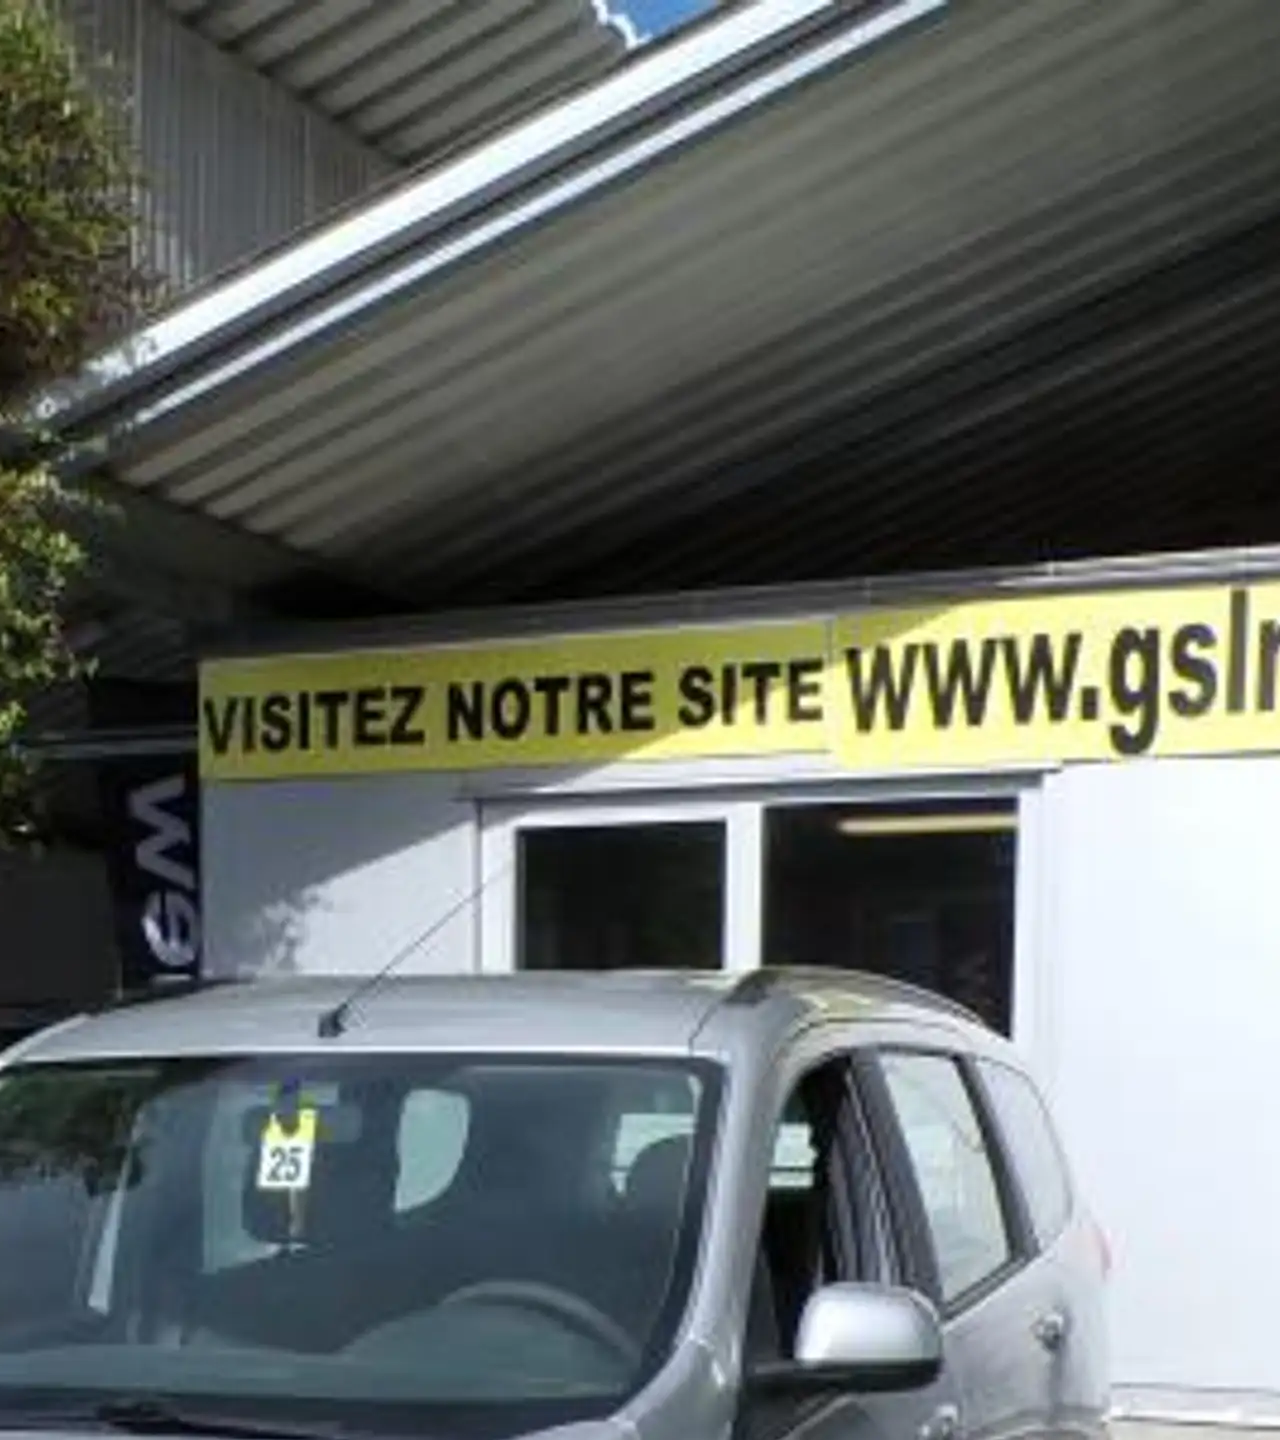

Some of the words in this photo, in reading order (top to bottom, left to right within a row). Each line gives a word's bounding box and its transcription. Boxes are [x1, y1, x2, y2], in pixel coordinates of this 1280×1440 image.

[202, 686, 425, 755] VISITEZ
[446, 671, 655, 741] NOTRE
[677, 658, 823, 727] SITE
[265, 1146, 304, 1182] 25
